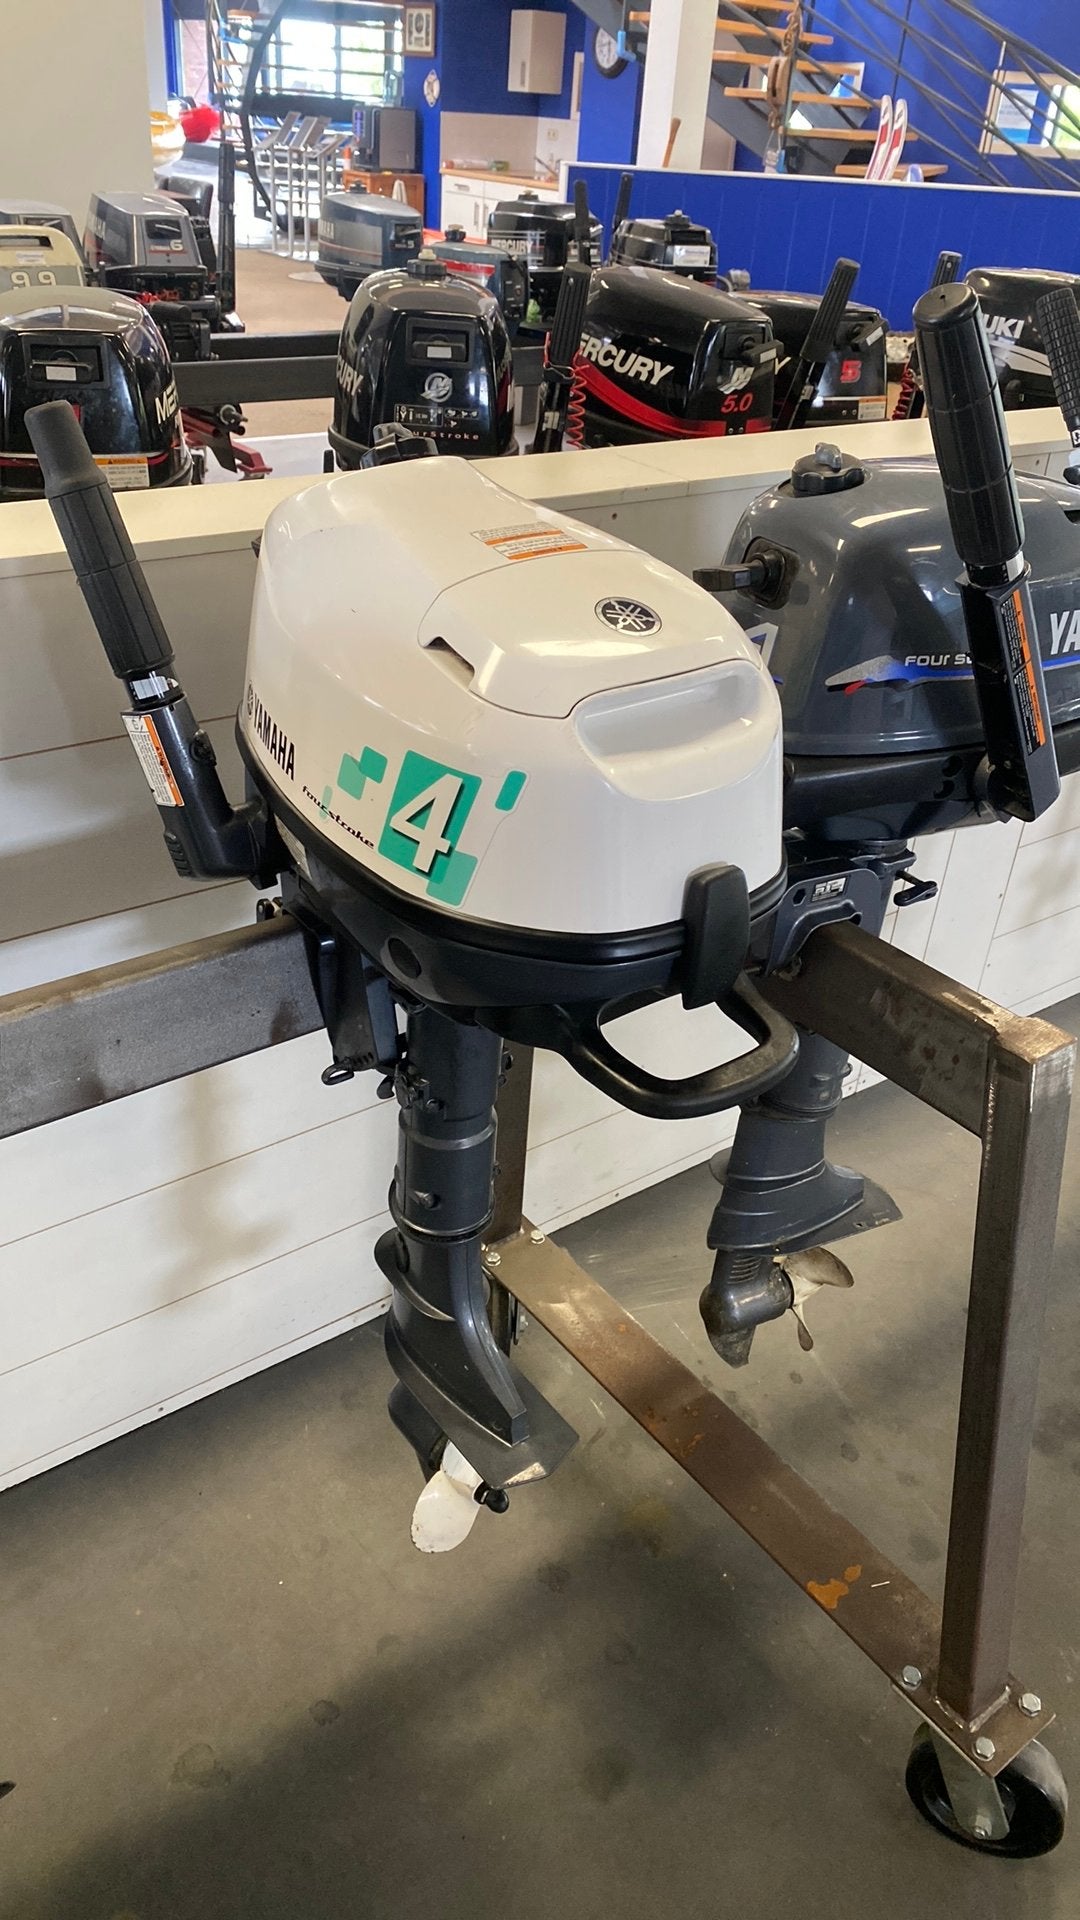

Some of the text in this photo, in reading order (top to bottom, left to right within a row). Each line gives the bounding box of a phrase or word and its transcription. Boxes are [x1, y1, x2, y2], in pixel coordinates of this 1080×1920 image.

[170, 239, 184, 251] 6
[983, 314, 1025, 339] UKI
[580, 332, 675, 386] ERCURY
[840, 359, 862, 383] 5
[721, 392, 753, 413] 5.0
[411, 430, 480, 441] urStroke
[252, 693, 296, 781] YAMAHA
[389, 772, 466, 878] 4
